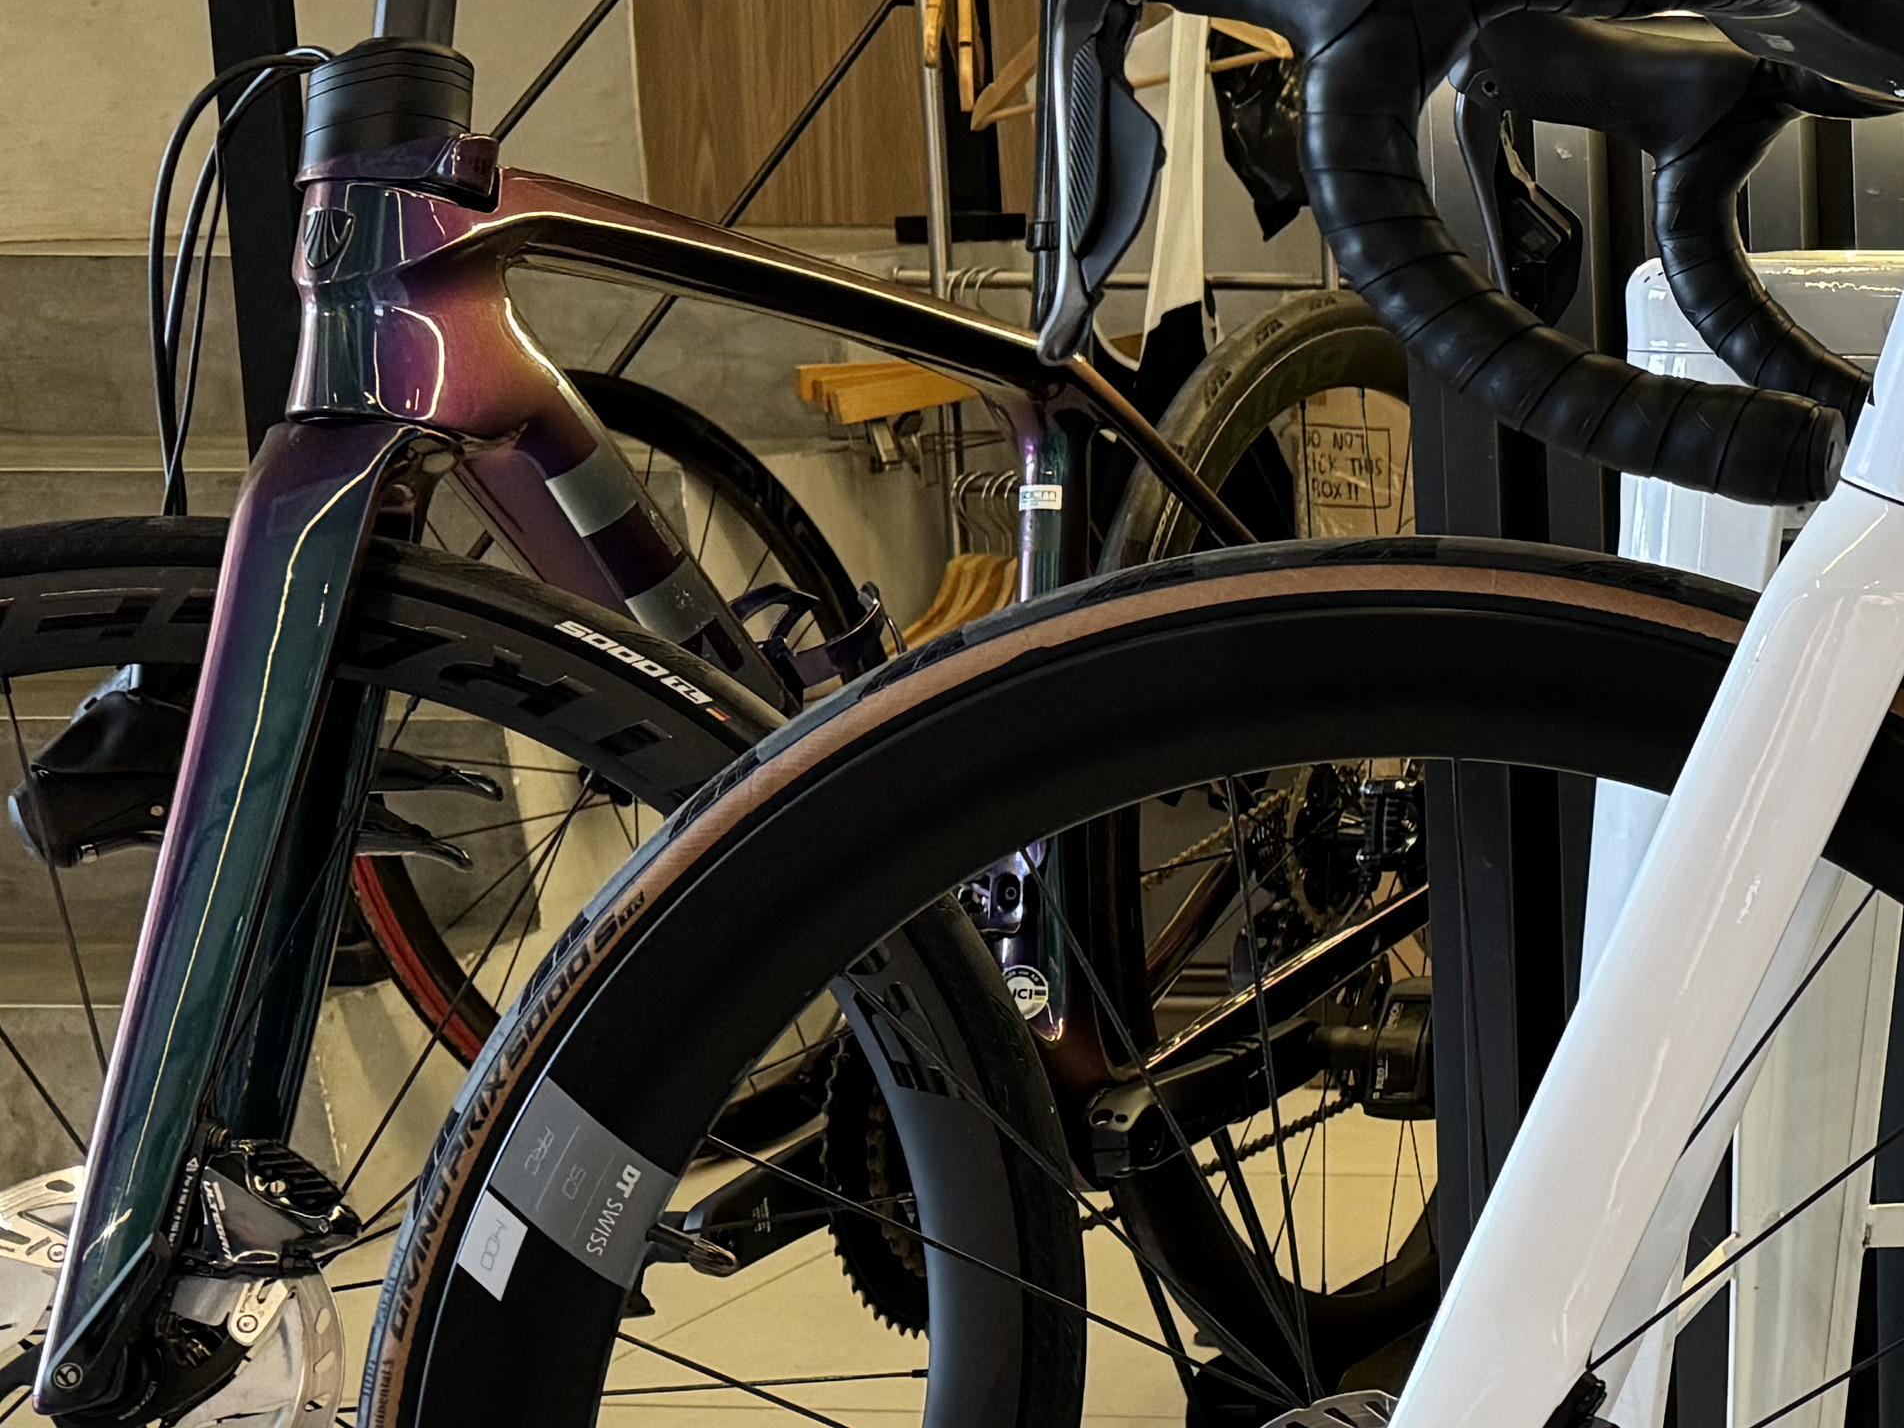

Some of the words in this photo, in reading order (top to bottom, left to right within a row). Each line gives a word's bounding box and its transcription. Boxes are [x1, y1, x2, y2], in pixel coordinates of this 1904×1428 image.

[554, 621, 670, 677] 5000
[615, 1163, 641, 1199] DT
[586, 1197, 624, 1256] SWISS
